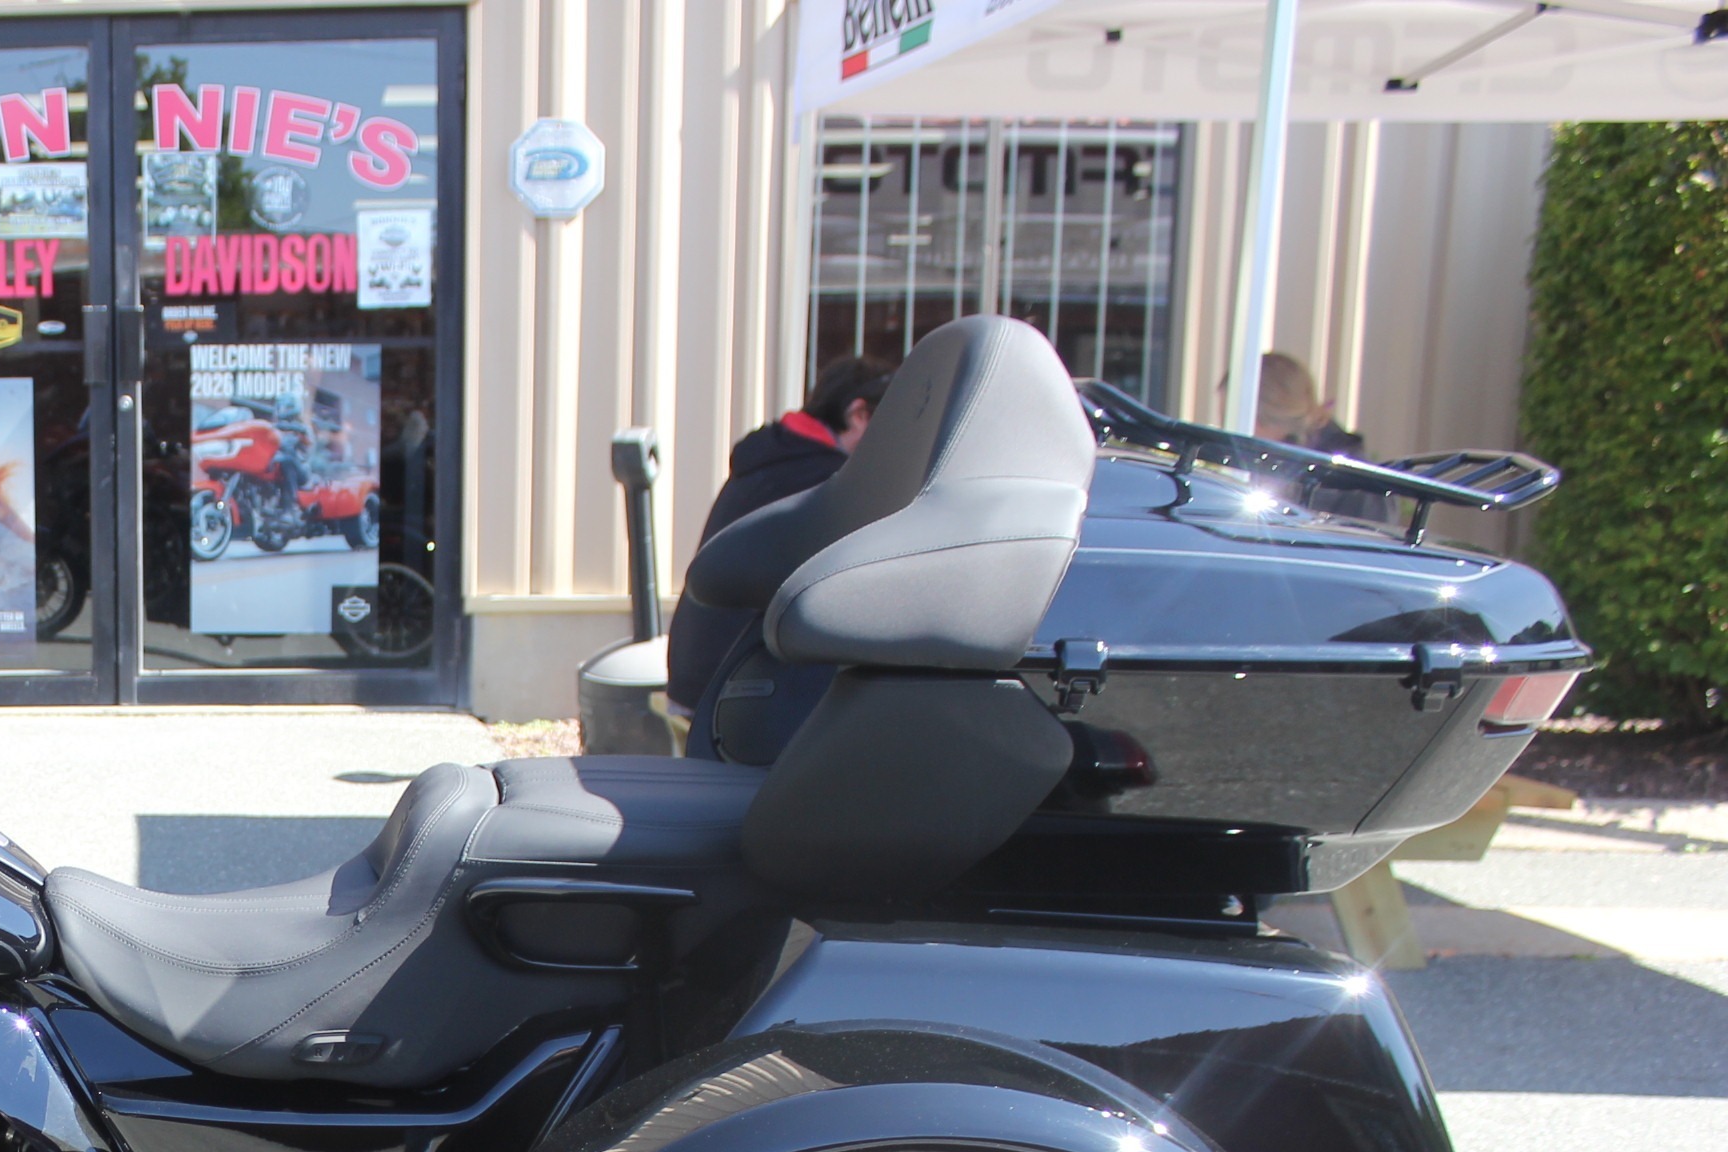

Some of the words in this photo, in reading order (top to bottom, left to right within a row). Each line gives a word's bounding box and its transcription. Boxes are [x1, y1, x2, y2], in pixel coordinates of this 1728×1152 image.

[165, 233, 358, 297] DAVIDSON
[189, 344, 274, 372] WELCOME
[276, 343, 309, 371] THE
[310, 343, 352, 372] NEW
[190, 372, 235, 399] 2026
[236, 371, 309, 399] MODELS.
